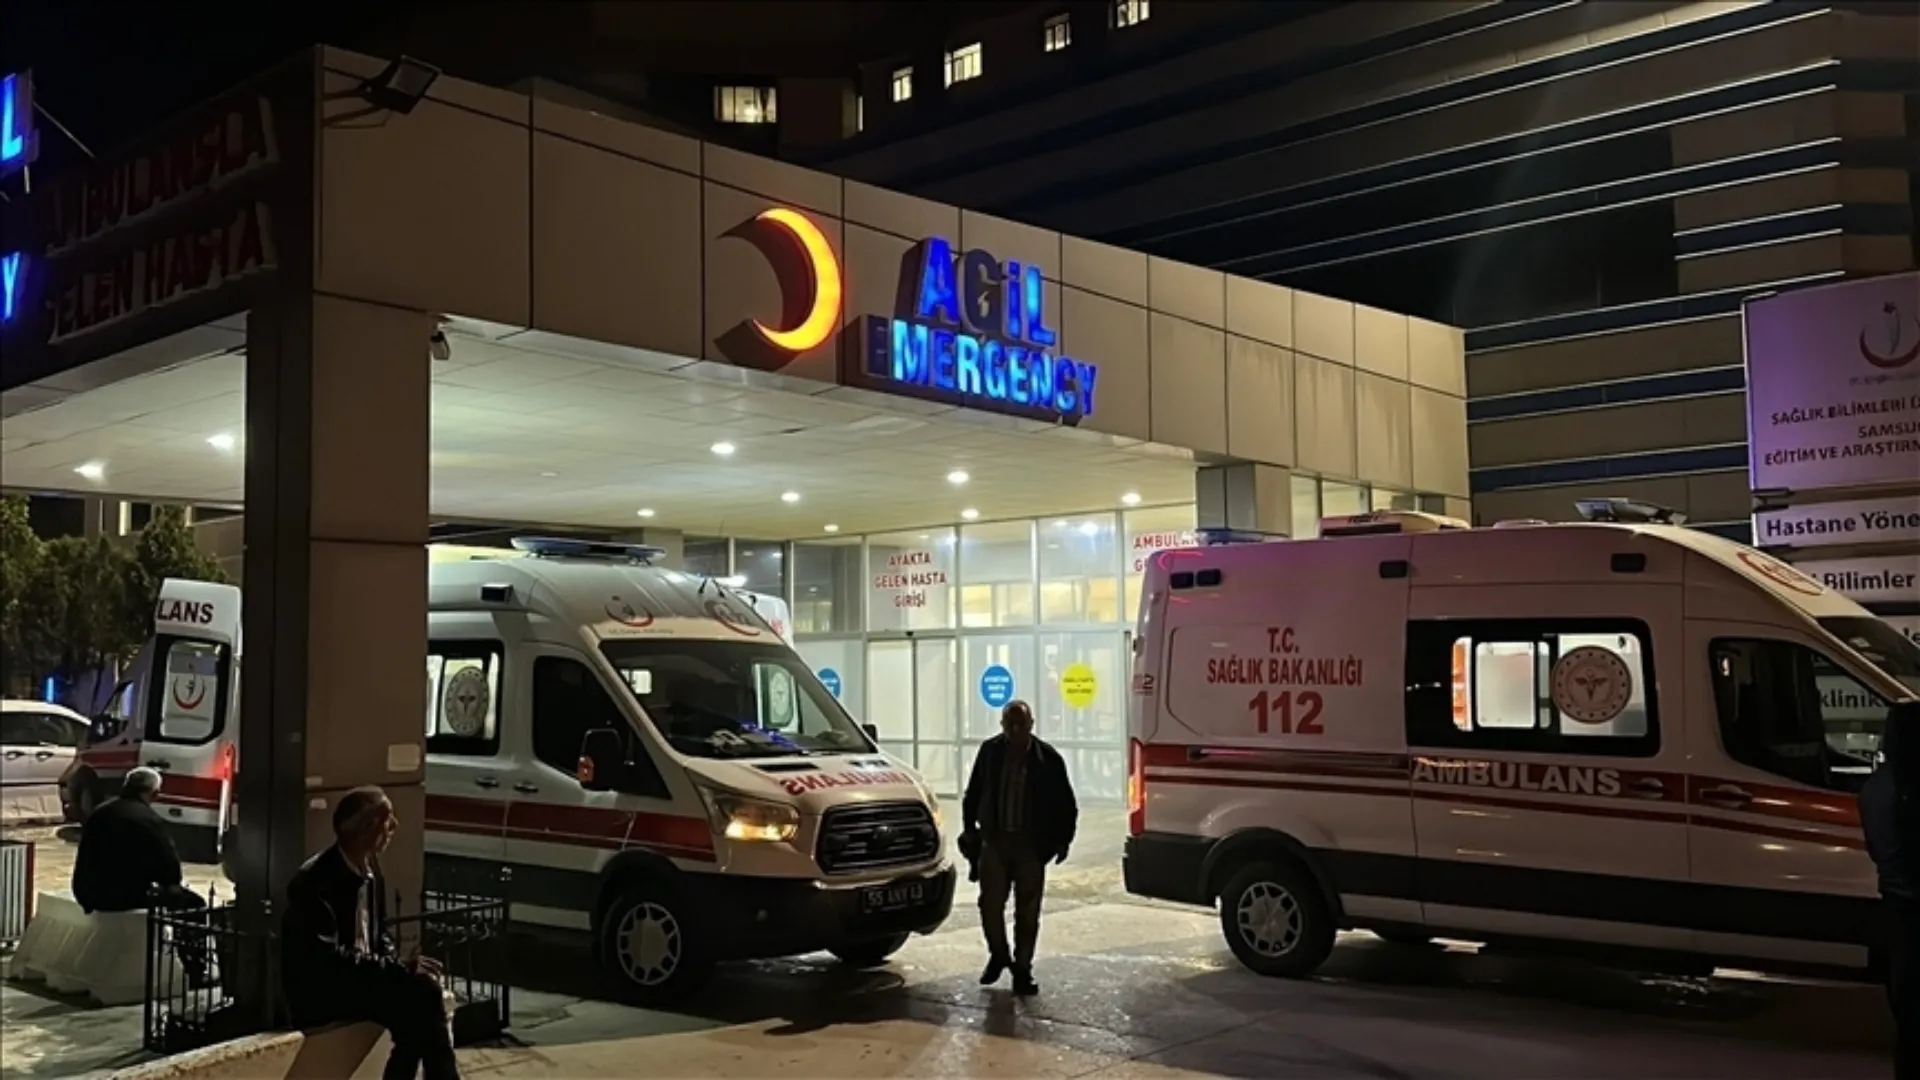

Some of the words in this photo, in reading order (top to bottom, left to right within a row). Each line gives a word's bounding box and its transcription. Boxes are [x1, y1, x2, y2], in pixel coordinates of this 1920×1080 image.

[865, 313, 1097, 417] EMERGENCY
[1771, 405, 1824, 425] SAĞLIK
[1828, 396, 1905, 418] BİLİMLERİ
[1858, 421, 1920, 439] SAMSU
[1764, 447, 1816, 466] EĞİTİM
[1819, 446, 1838, 460] VE
[1767, 517, 1856, 537] Hastane
[1860, 511, 1920, 530] Yöne
[889, 552, 931, 566] AYAKTA
[874, 573, 907, 588] GELEN
[911, 571, 946, 586] HASTA
[1823, 570, 1915, 593] Bilimler
[158, 600, 214, 624] LANS
[1267, 627, 1299, 654] T.C.
[1207, 654, 1263, 684] SAĞLIK
[1268, 654, 1362, 687] BAKANLIĞI
[1249, 691, 1324, 734] 112
[1412, 756, 1621, 796] AMBULANS
